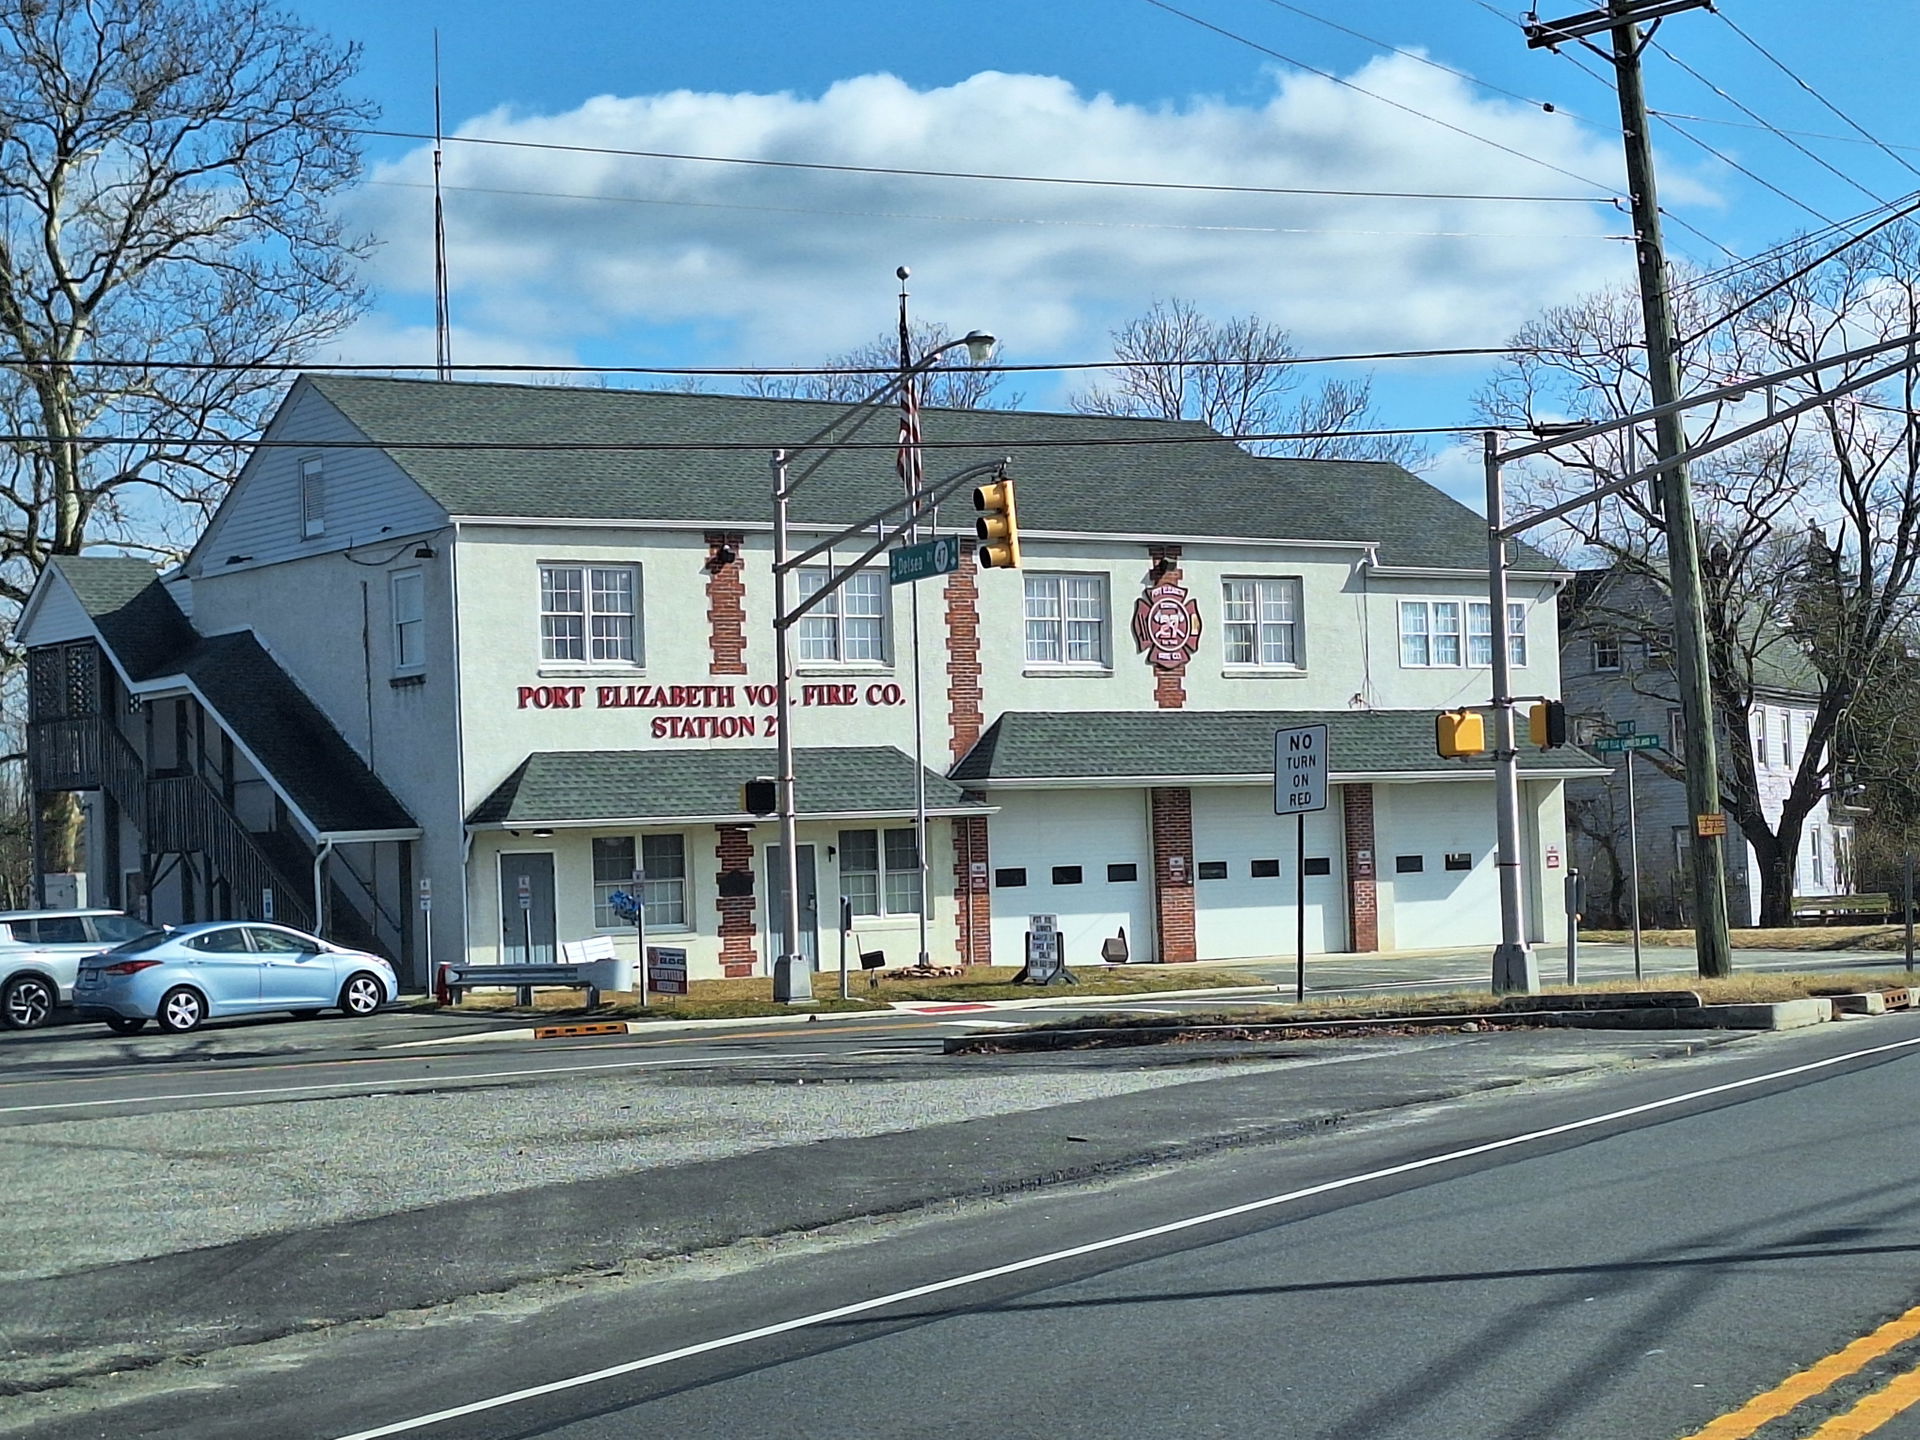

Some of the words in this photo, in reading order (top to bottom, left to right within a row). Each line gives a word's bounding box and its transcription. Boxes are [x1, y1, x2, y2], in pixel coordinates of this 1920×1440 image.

[898, 556, 923, 575] Delsea
[517, 686, 586, 709] PORT
[597, 685, 736, 708] ELIZABETH
[743, 684, 797, 707] VO.
[802, 684, 858, 706] FIRE
[866, 683, 906, 706] CO.
[651, 716, 755, 738] STATION
[1290, 734, 1312, 751] NO
[1287, 755, 1316, 770] TURN
[1293, 773, 1309, 788] ON
[1289, 792, 1312, 807] RED
